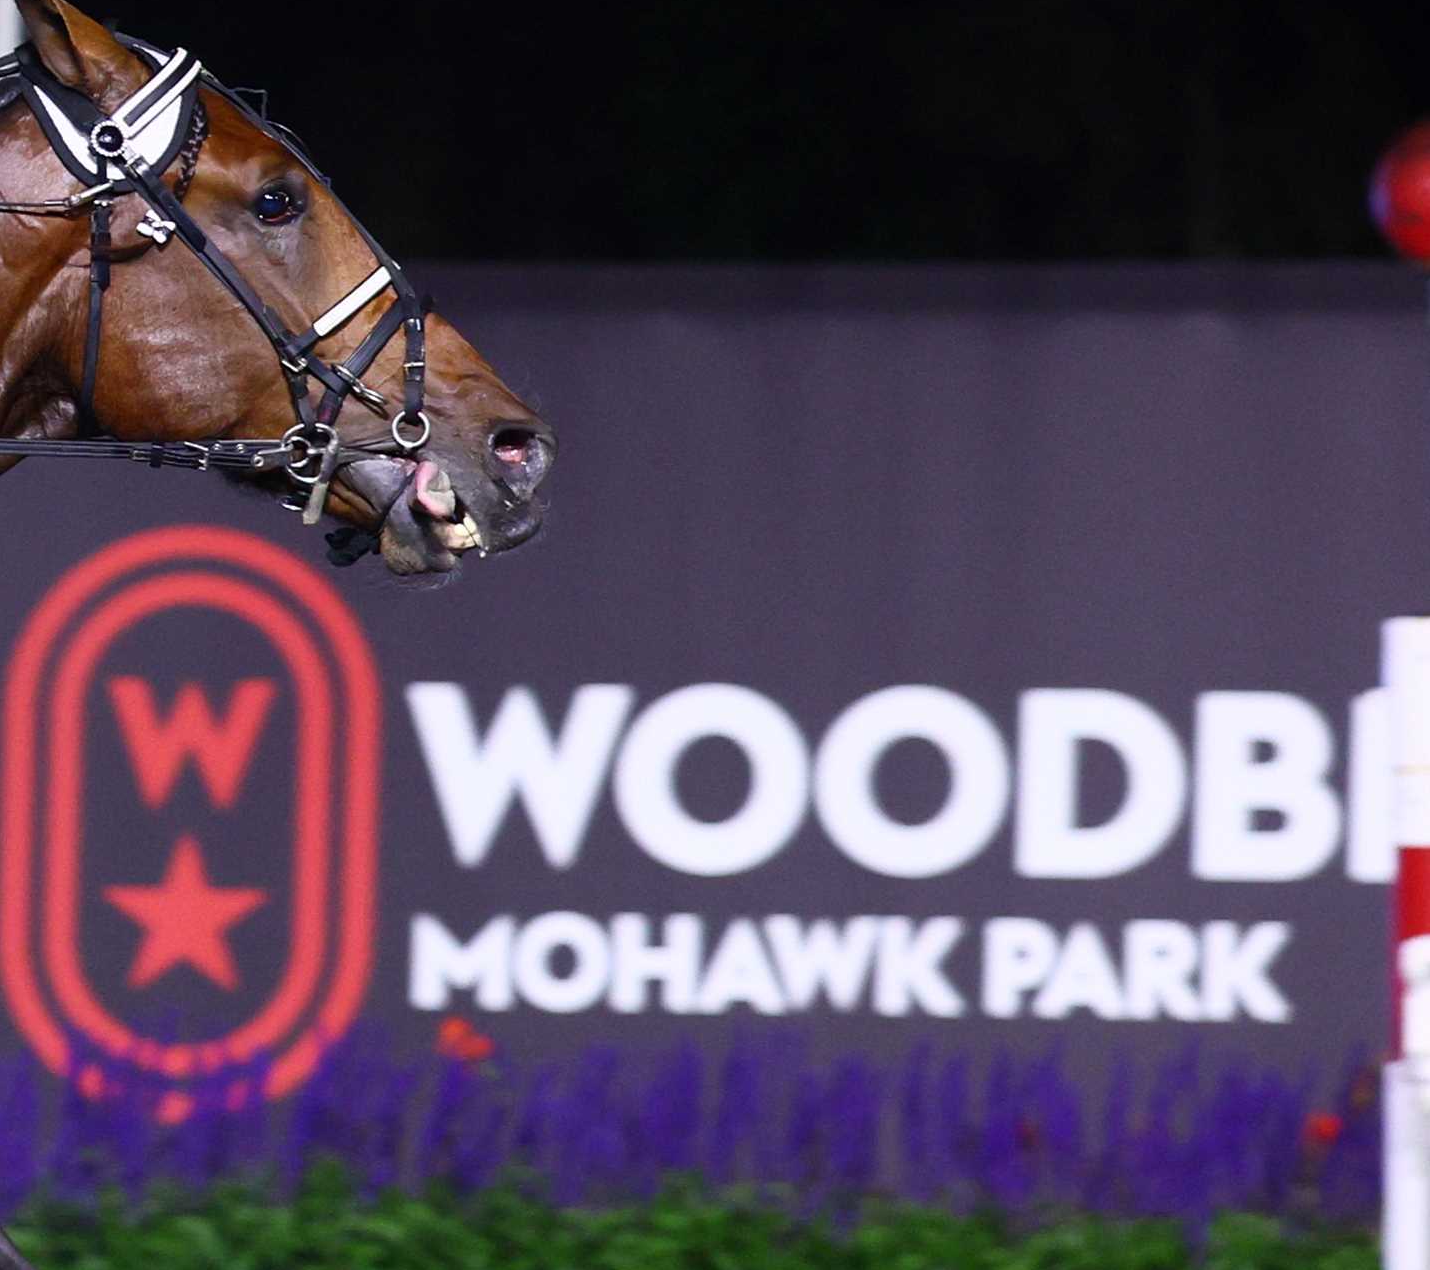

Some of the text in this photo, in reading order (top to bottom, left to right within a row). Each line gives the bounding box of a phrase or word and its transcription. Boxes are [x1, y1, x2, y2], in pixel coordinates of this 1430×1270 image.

[104, 674, 277, 812] W
[408, 911, 1293, 1023] MOHAWK PARK
